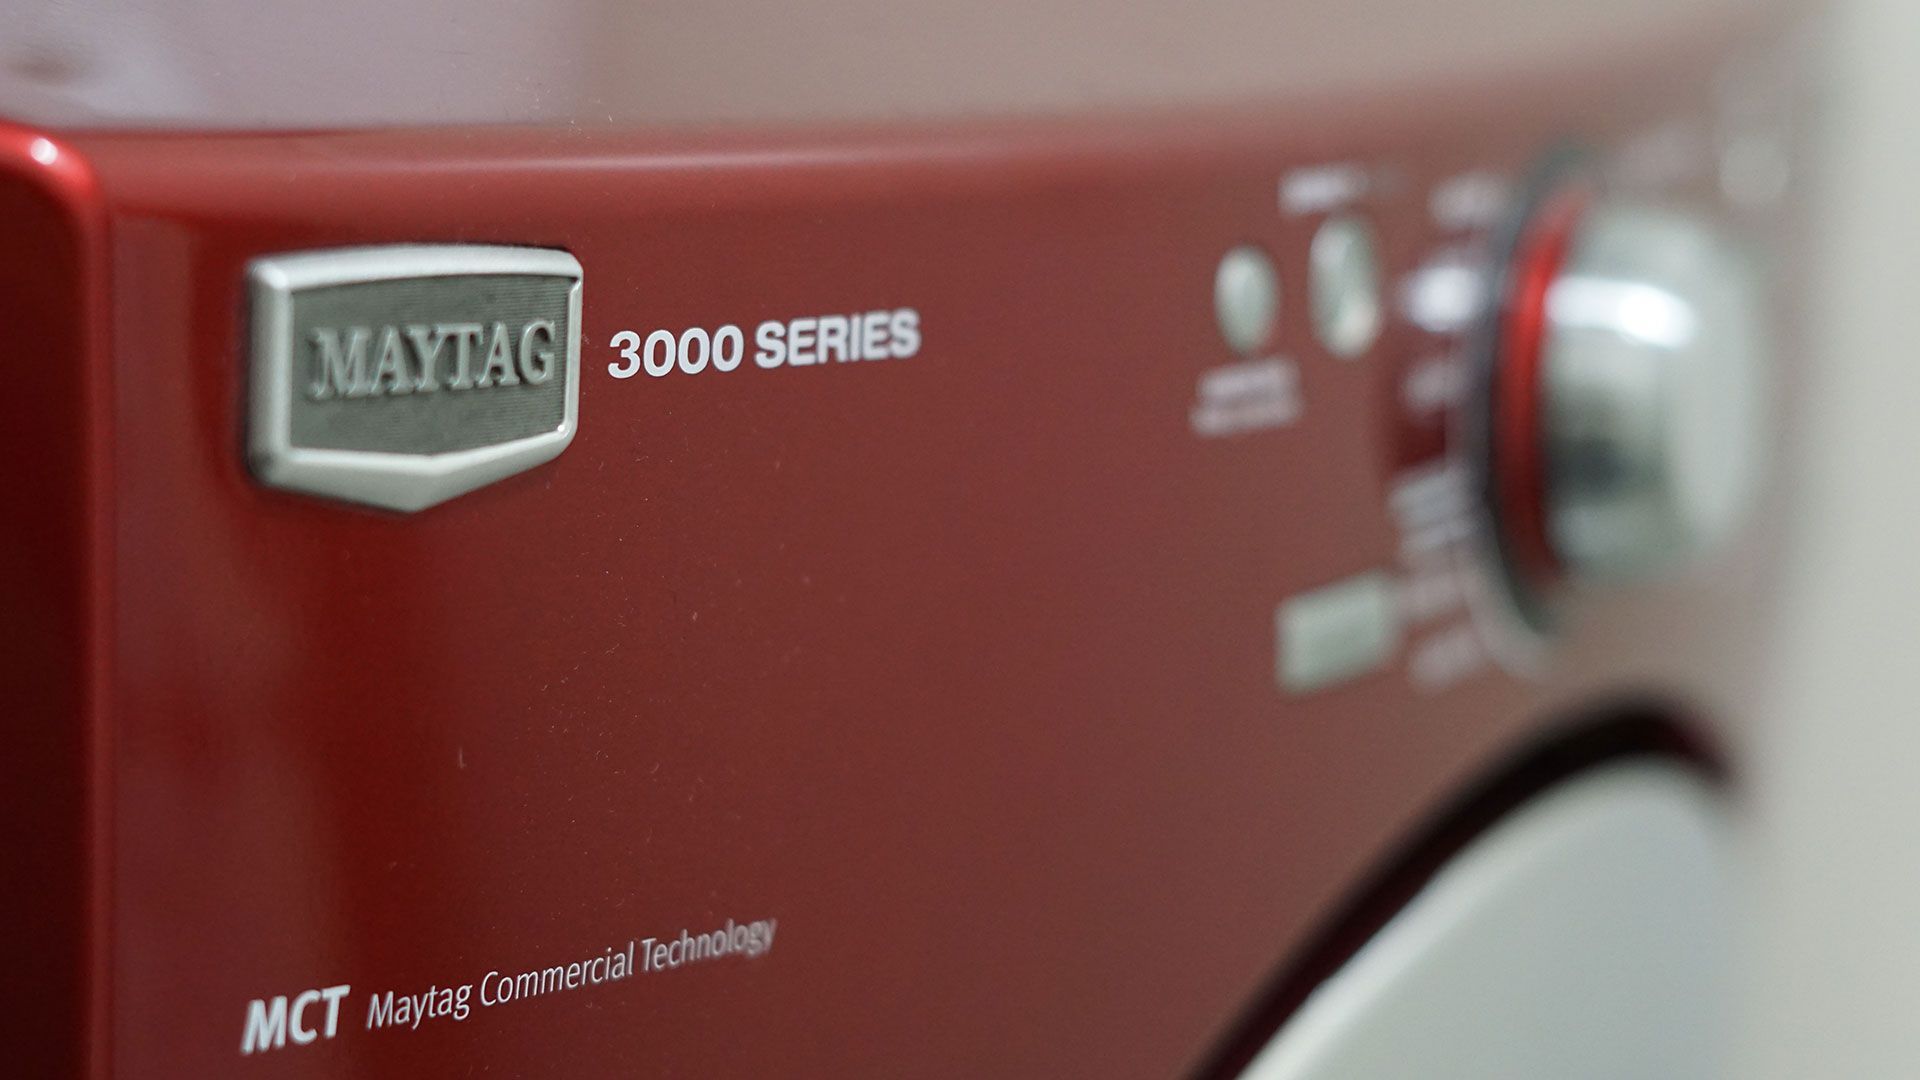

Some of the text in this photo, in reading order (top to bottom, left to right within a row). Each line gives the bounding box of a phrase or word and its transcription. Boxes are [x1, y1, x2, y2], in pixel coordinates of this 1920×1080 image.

[309, 319, 557, 400] MAYTAG
[607, 308, 921, 379] 3000 SERIES
[241, 917, 777, 1055] MCT Maytag Commercial Technology
